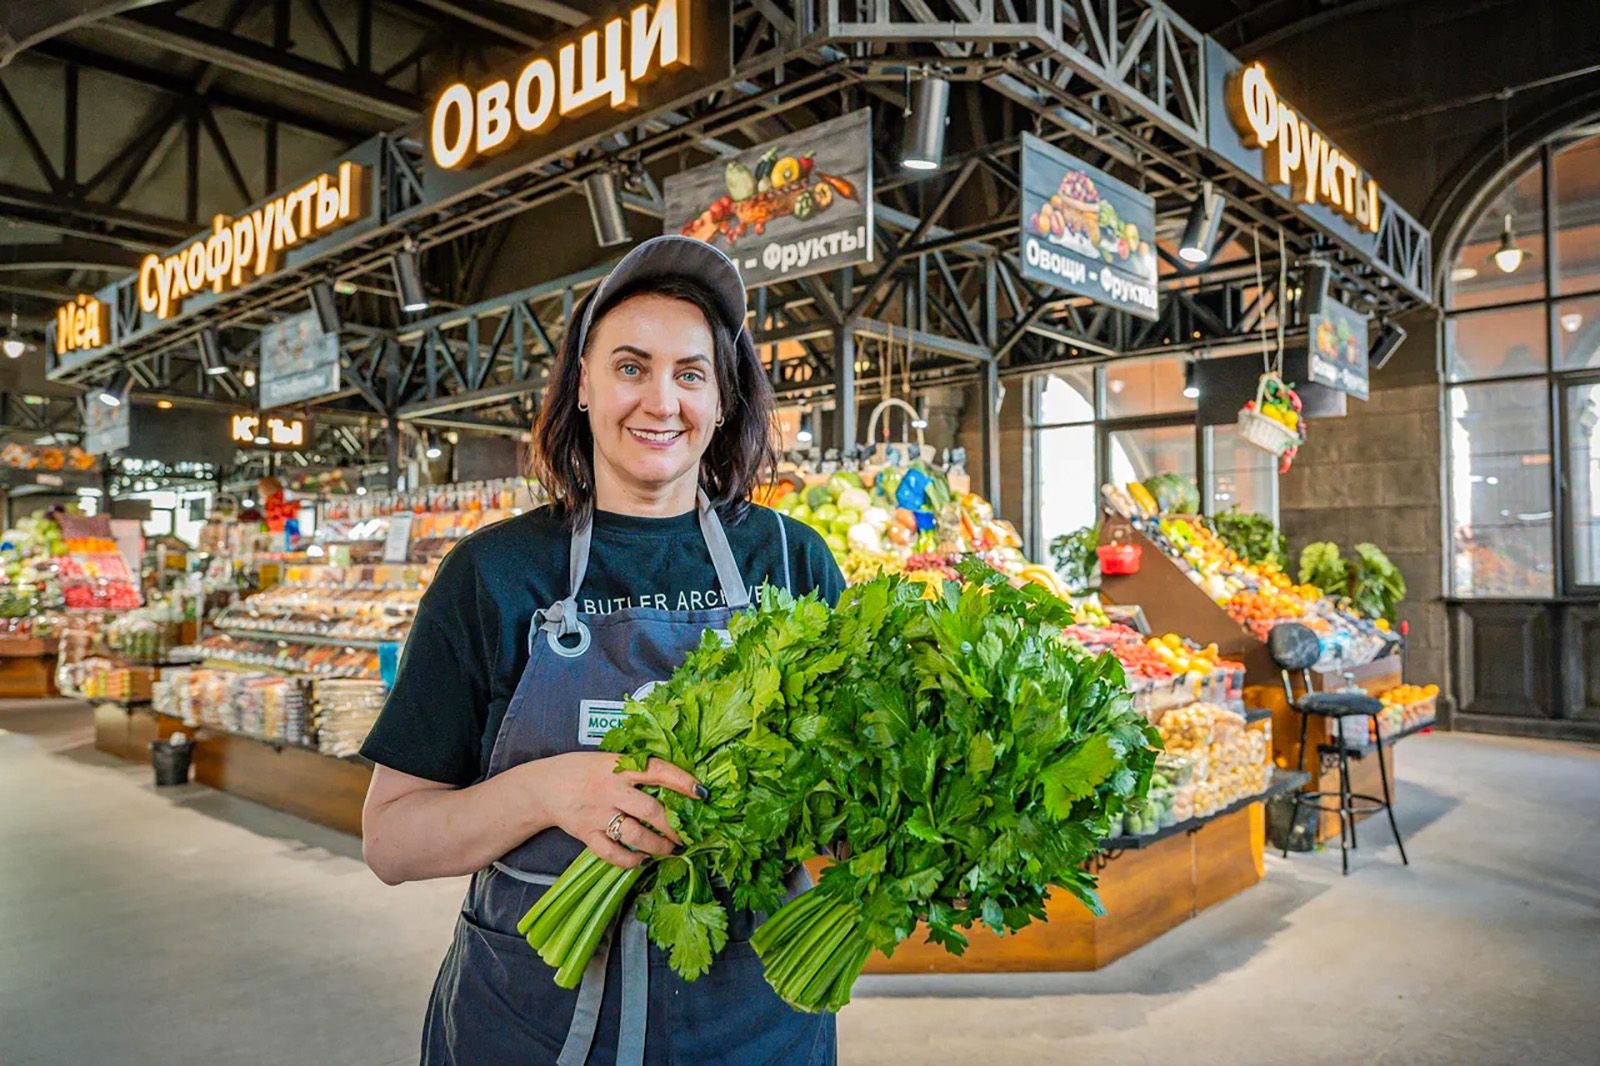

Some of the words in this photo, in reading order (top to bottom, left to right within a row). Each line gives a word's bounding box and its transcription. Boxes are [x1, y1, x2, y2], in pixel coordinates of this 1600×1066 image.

[431, 0, 679, 170] Овощи
[1242, 61, 1380, 233] Фрукты
[138, 160, 351, 320] Сухофрукты
[762, 225, 866, 273] Фрукты
[1026, 238, 1086, 284] Овощи
[1100, 266, 1158, 310] Фрукты
